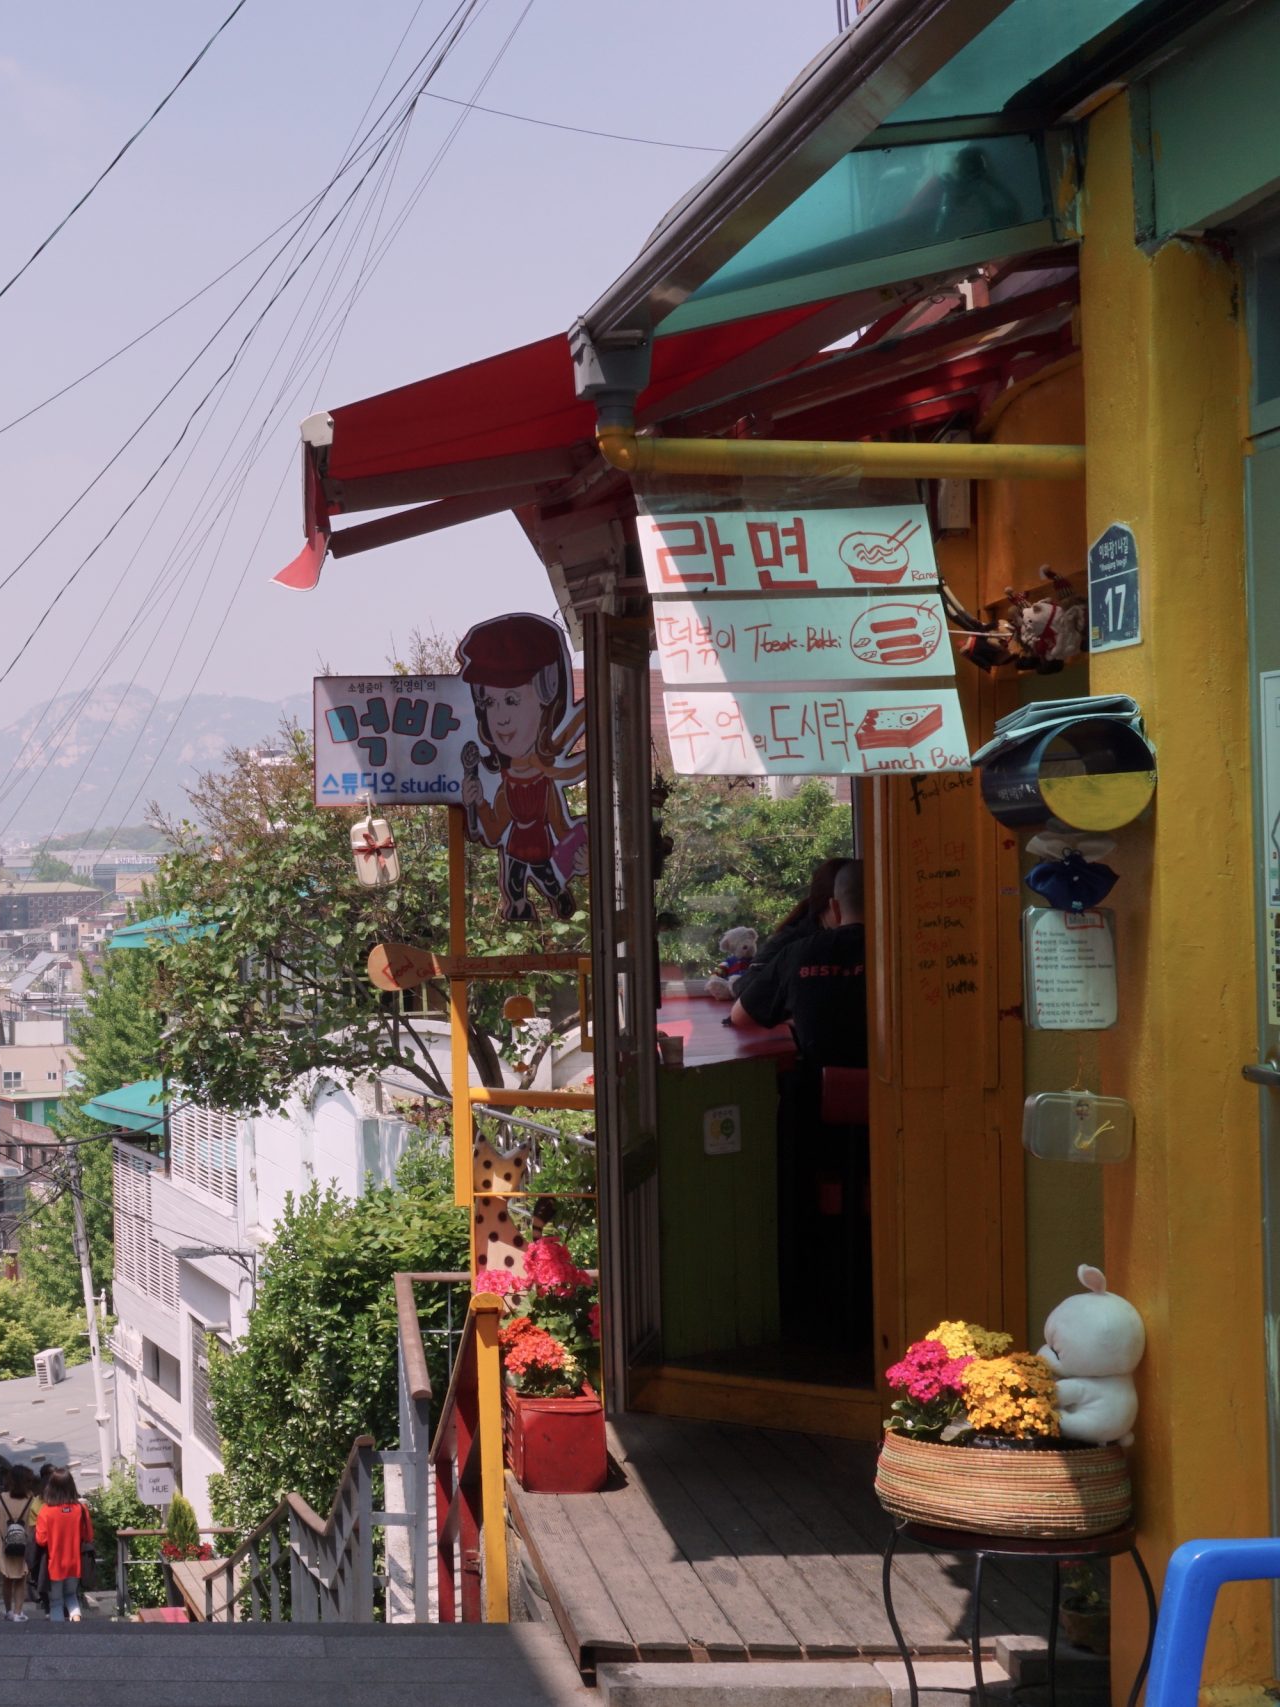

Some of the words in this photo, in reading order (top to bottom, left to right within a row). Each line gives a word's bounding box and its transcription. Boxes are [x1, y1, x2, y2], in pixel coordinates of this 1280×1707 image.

[651, 516, 818, 589] 라면
[1104, 583, 1126, 632] 17
[656, 615, 736, 674] 떡볶이
[325, 697, 460, 766] 먹방
[768, 698, 854, 763] 도시락
[321, 771, 397, 795] 스튜디오
[400, 772, 460, 794] studio
[861, 750, 923, 773] Lunch
[931, 748, 971, 770] Box
[799, 965, 839, 978] BEST
[152, 1485, 169, 1493] HUE
